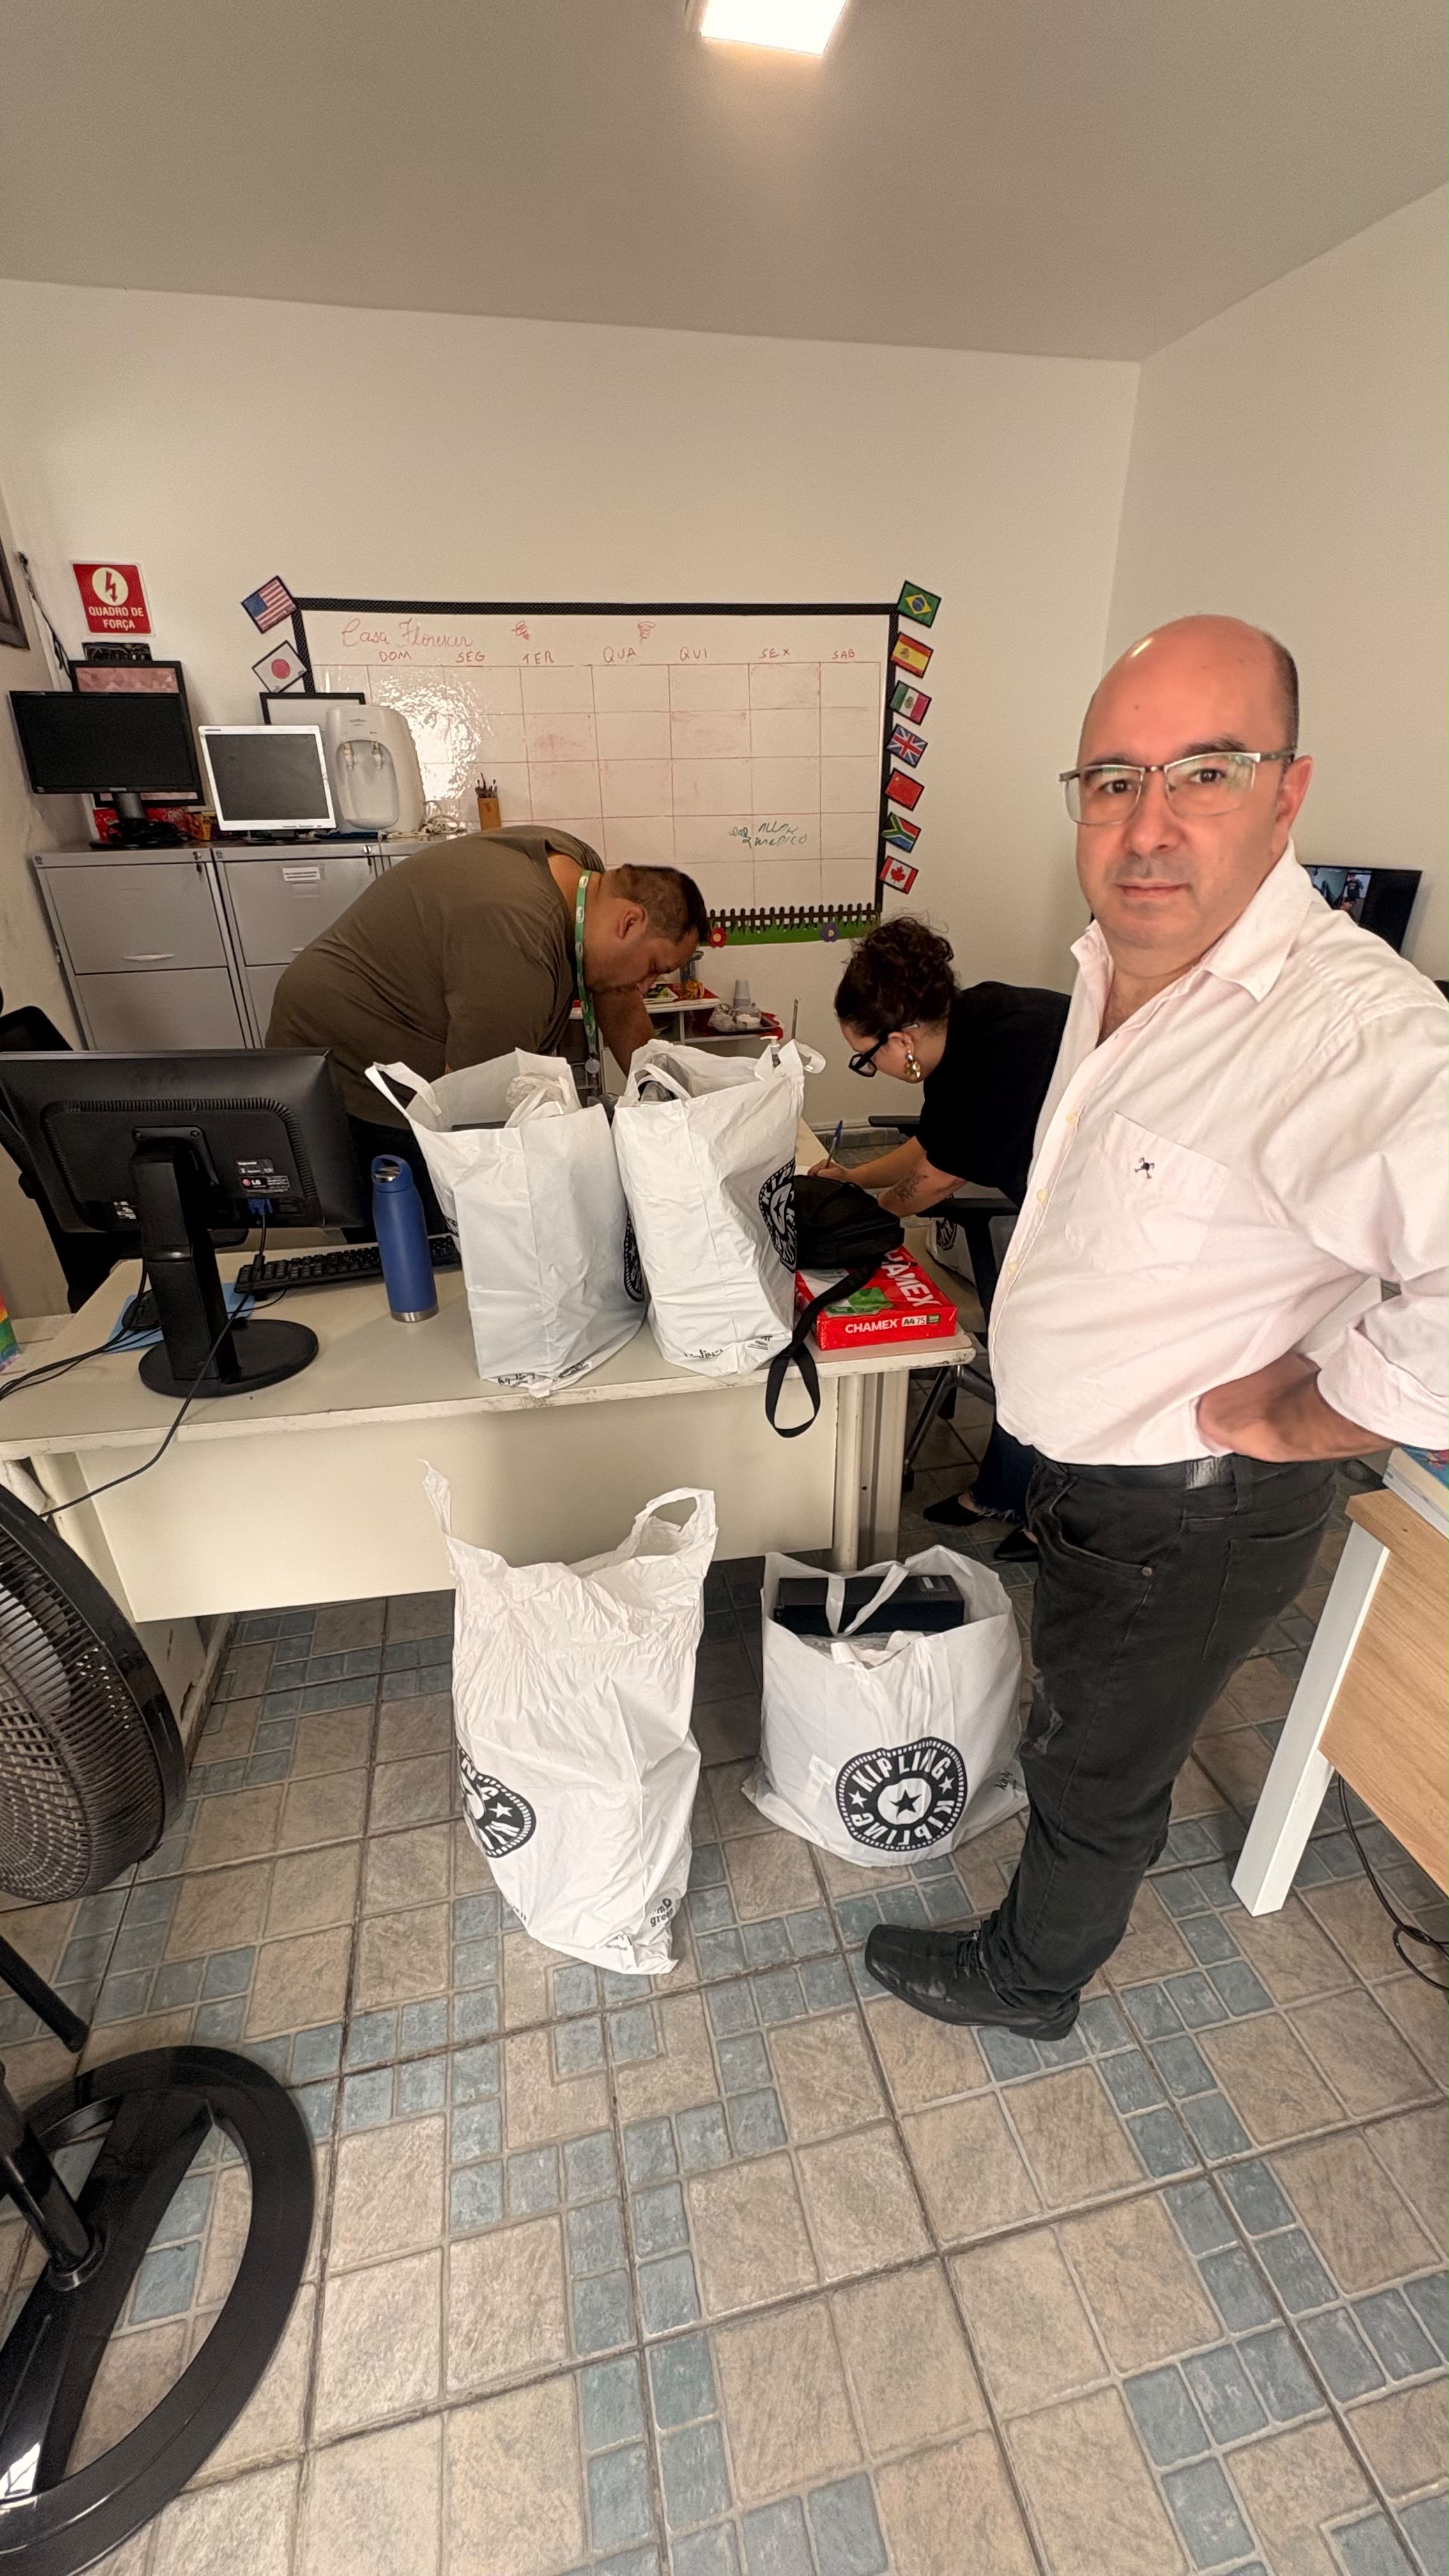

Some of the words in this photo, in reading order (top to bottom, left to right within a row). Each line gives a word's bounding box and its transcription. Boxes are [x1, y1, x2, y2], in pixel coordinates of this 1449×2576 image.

[88, 606, 128, 617] QUADRO
[130, 607, 144, 617] DE
[103, 619, 135, 631] FORÇA
[341, 618, 390, 647] Casa
[379, 650, 411, 663] DOM
[455, 651, 485, 663] SEG
[523, 650, 555, 666] TER
[603, 647, 638, 663] QUA
[680, 646, 707, 661] QUI
[758, 648, 791, 659] SEX
[832, 648, 855, 660] SAB
[881, 1248, 942, 1307] CAMEX
[845, 1319, 898, 1334] CHAMEX
[851, 1749, 951, 1793] KIPLING
[850, 1800, 955, 1846] KIPLING
